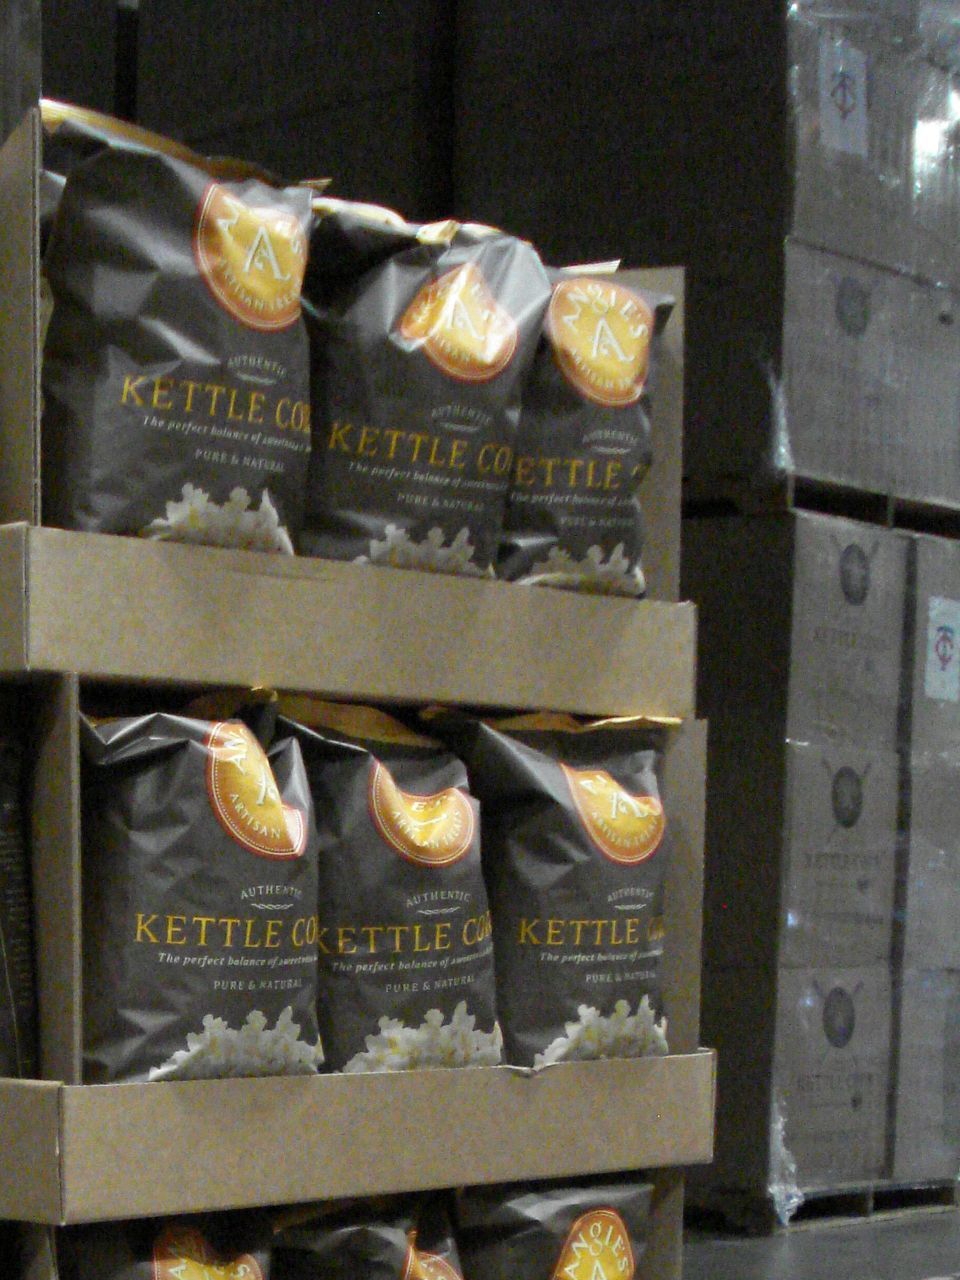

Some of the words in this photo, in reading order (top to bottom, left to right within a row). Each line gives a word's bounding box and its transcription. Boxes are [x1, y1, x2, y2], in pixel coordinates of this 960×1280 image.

[120, 373, 267, 425] KETTLE
[167, 420, 210, 438] perfect
[329, 420, 468, 468] KETTLE
[477, 443, 513, 474] CO
[194, 448, 228, 464] PURE
[242, 456, 285, 473] NATURAL
[230, 793, 281, 839] ARTISAN
[406, 889, 472, 908] AUTHENTIC
[134, 912, 283, 950] KETTLE
[292, 913, 318, 947] CO
[317, 923, 451, 955] KETTLE
[518, 917, 640, 947] KETTLE
[157, 951, 180, 964] The
[182, 954, 225, 969] perfect
[228, 953, 266, 966] balance
[333, 961, 354, 971] The
[355, 960, 397, 974] perfect
[398, 958, 438, 970] balance
[213, 979, 244, 992] PURE
[258, 976, 302, 991] NATURAL
[385, 982, 419, 994] PURE
[434, 974, 476, 990] NATURAL
